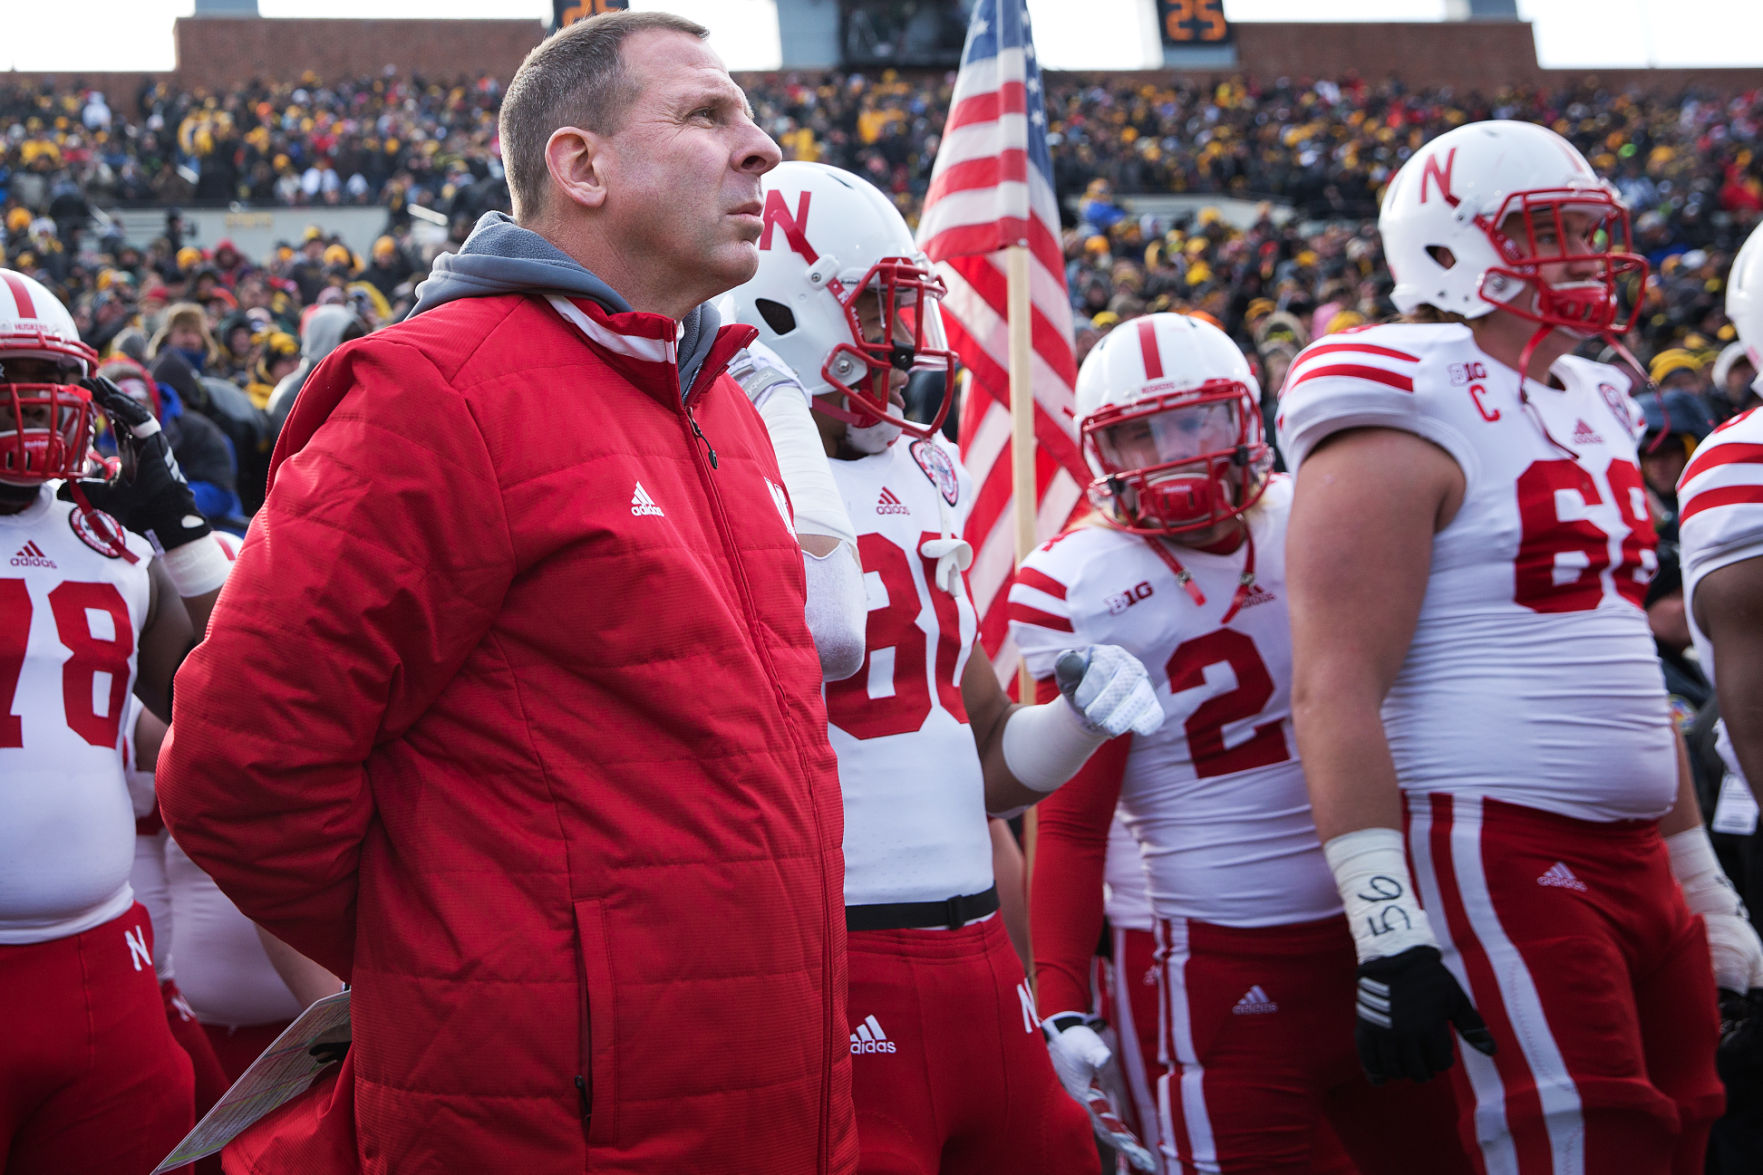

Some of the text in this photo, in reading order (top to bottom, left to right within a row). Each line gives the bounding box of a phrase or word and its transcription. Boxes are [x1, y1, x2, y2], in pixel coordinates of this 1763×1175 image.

[1165, 0, 1227, 41] 25
[1420, 147, 1457, 204] N
[758, 189, 811, 253] N
[1469, 384, 1500, 422] C
[9, 556, 58, 570] adidas
[1514, 457, 1660, 614] 68
[1164, 627, 1292, 780] 2
[1357, 875, 1412, 937] 56
[124, 924, 153, 971] N
[1016, 976, 1041, 1034] N
[850, 1039, 896, 1055] didas
